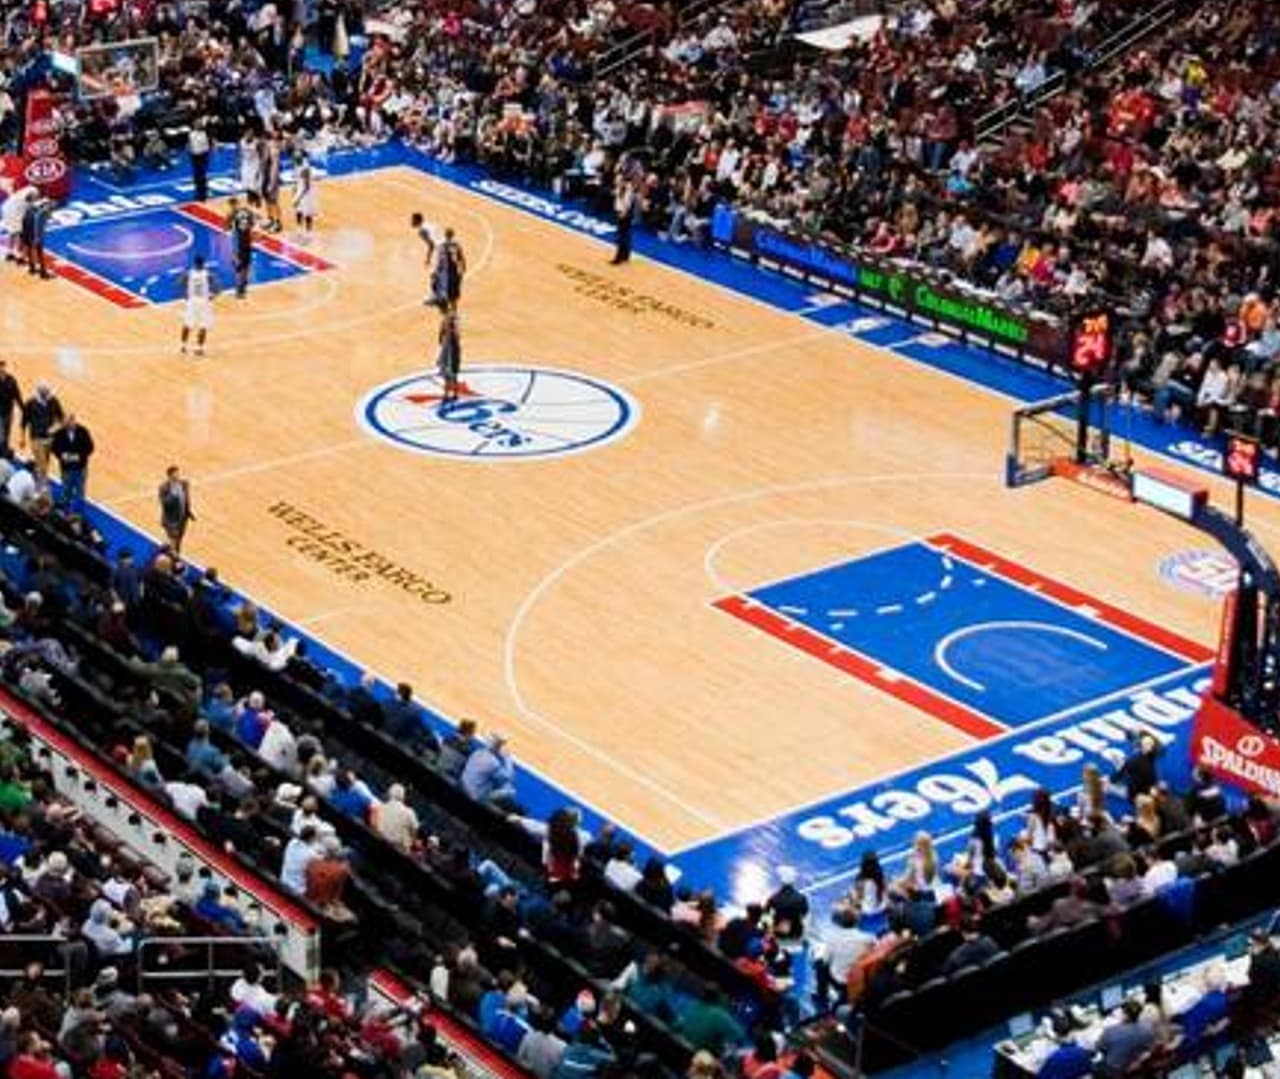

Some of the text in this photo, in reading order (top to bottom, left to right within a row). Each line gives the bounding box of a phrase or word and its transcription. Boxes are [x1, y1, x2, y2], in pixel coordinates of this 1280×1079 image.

[268, 501, 452, 604] WELLS FARGO
[796, 756, 1040, 850] 76ers
